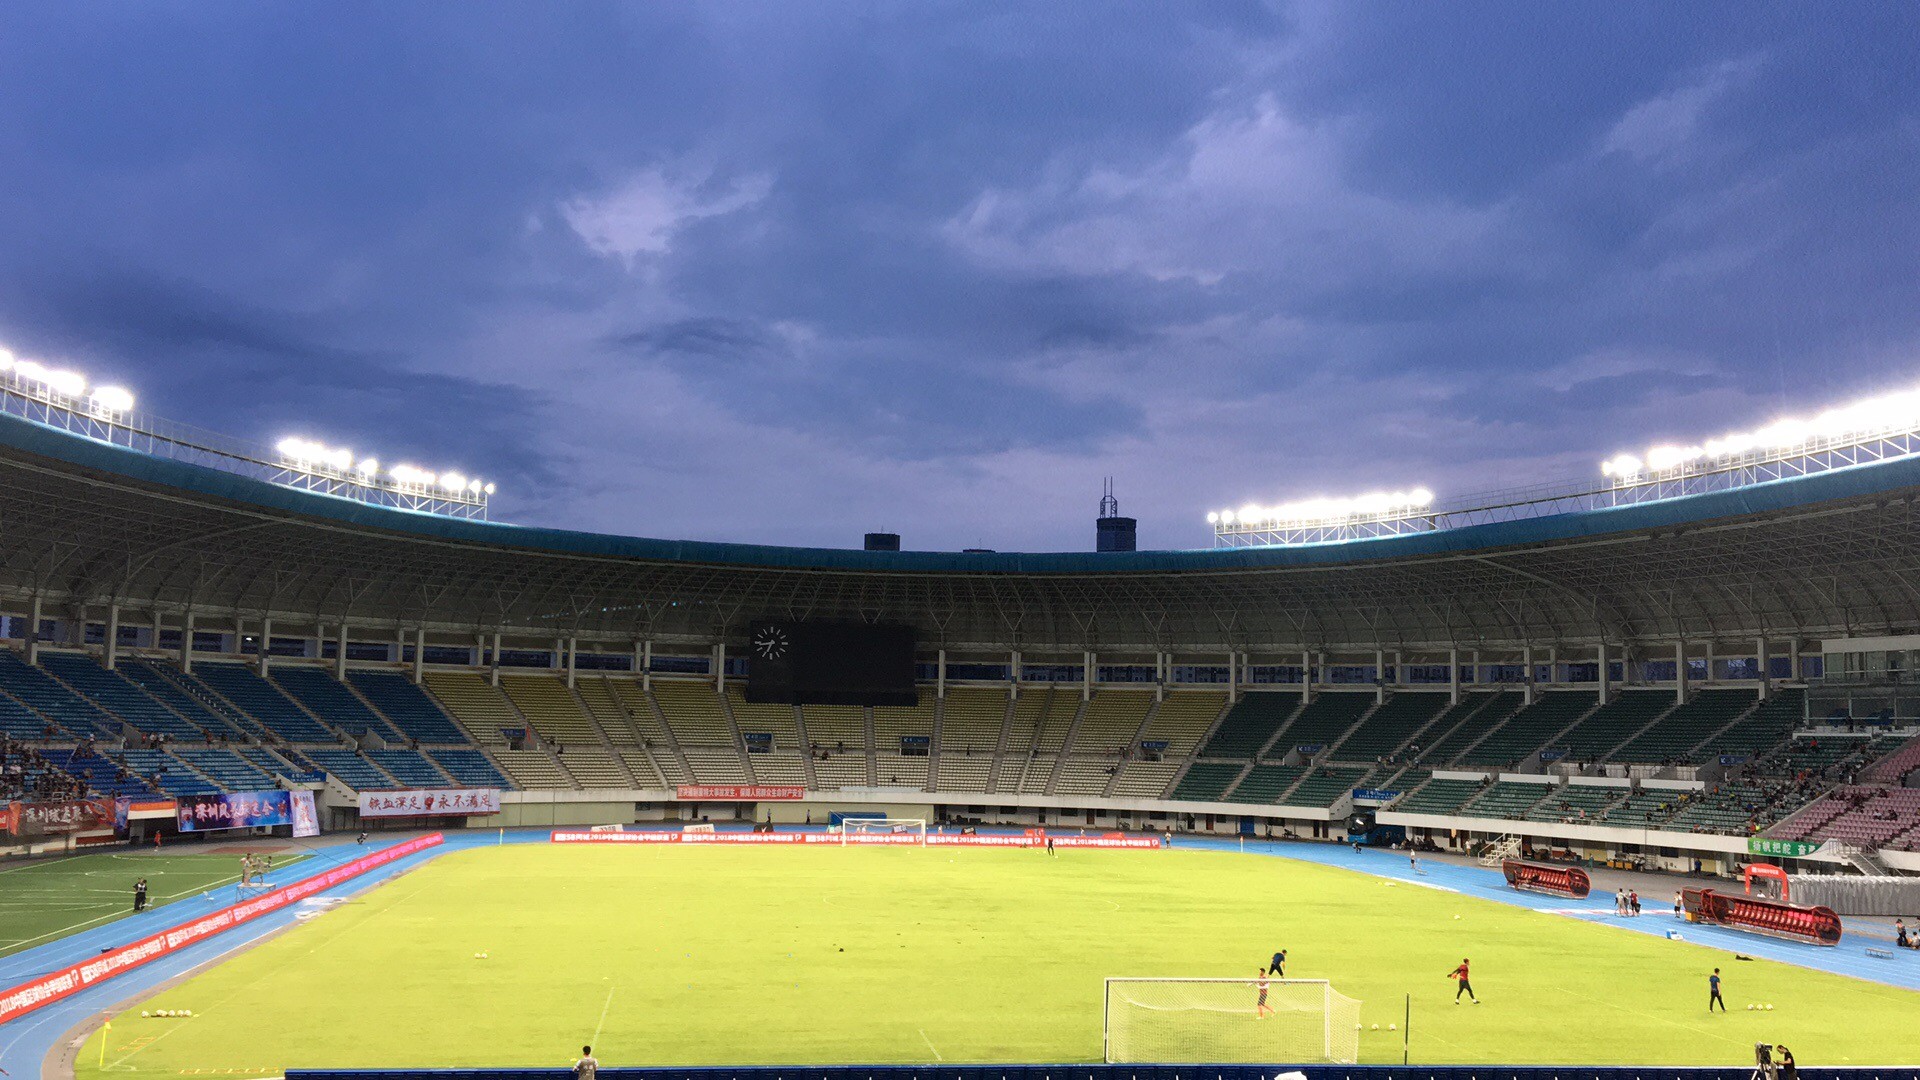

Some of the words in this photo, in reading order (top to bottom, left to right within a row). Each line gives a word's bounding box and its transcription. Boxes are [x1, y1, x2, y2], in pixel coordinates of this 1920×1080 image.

[368, 796, 421, 811] 铁血深足
[438, 794, 493, 809] 永不满足
[1752, 840, 1792, 855] 扬帆把舵
